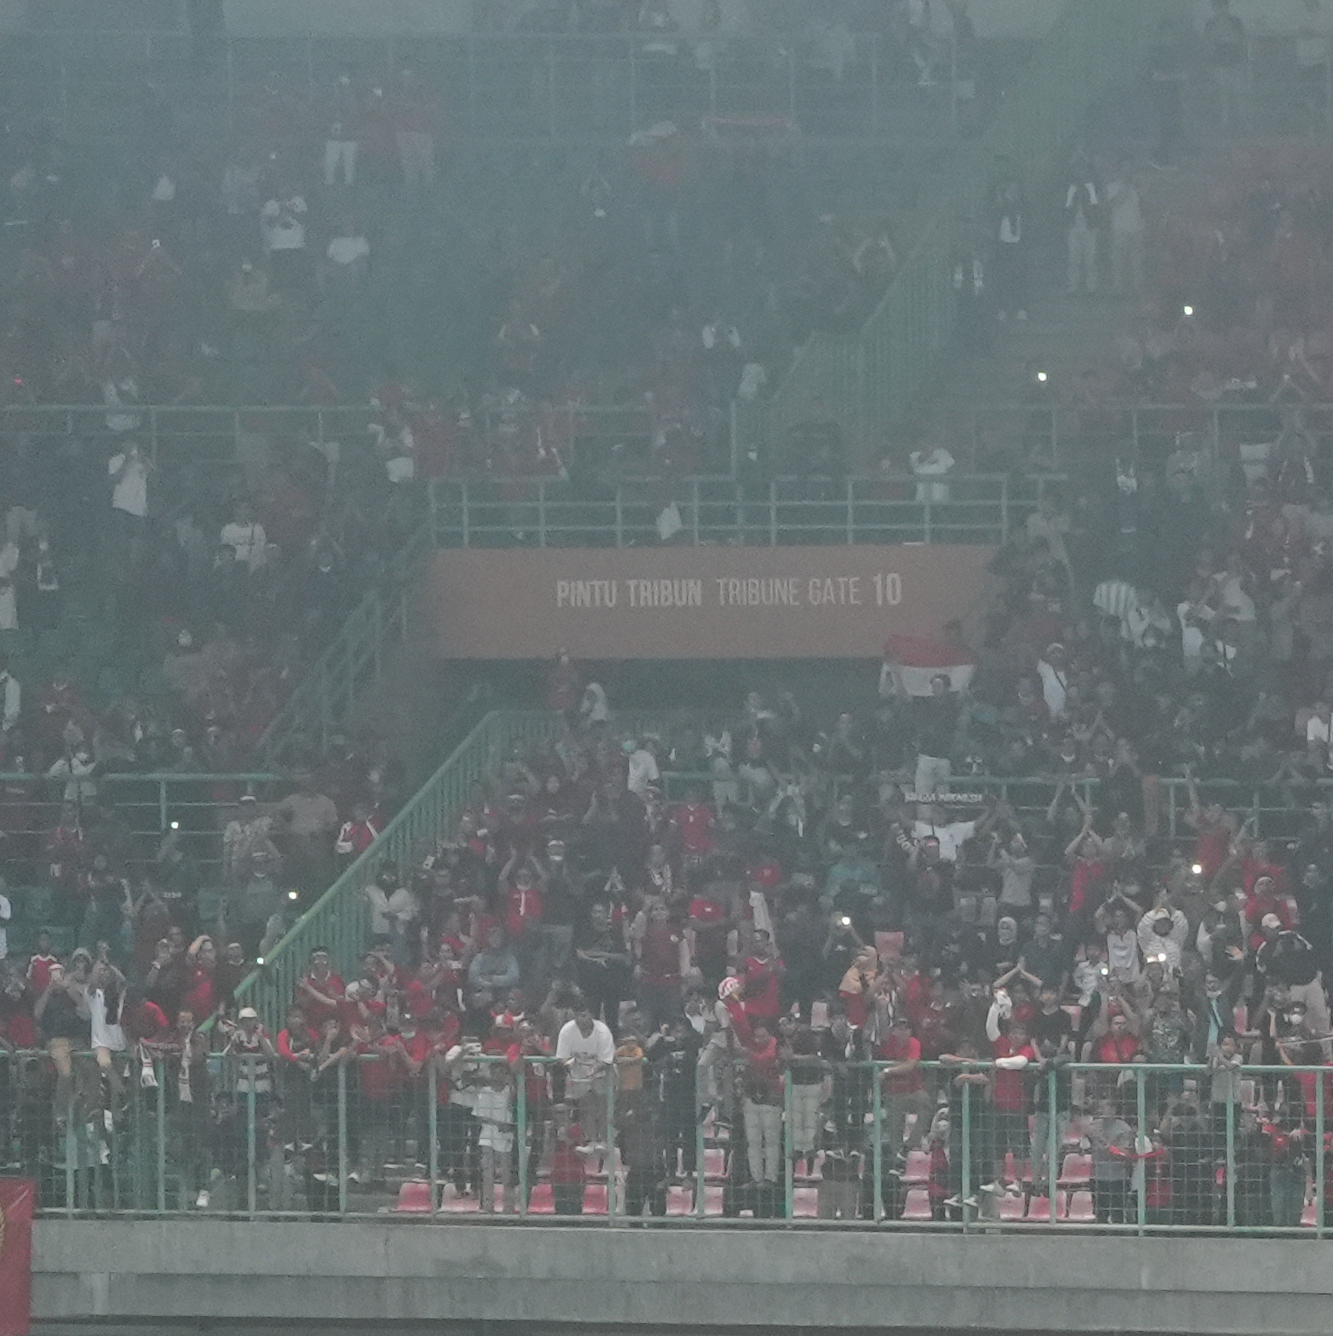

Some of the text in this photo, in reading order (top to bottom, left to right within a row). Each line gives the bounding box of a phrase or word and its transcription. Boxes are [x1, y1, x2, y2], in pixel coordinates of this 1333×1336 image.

[557, 573, 902, 607] PINTU TRIBUN TRIBUNE GATE 10
